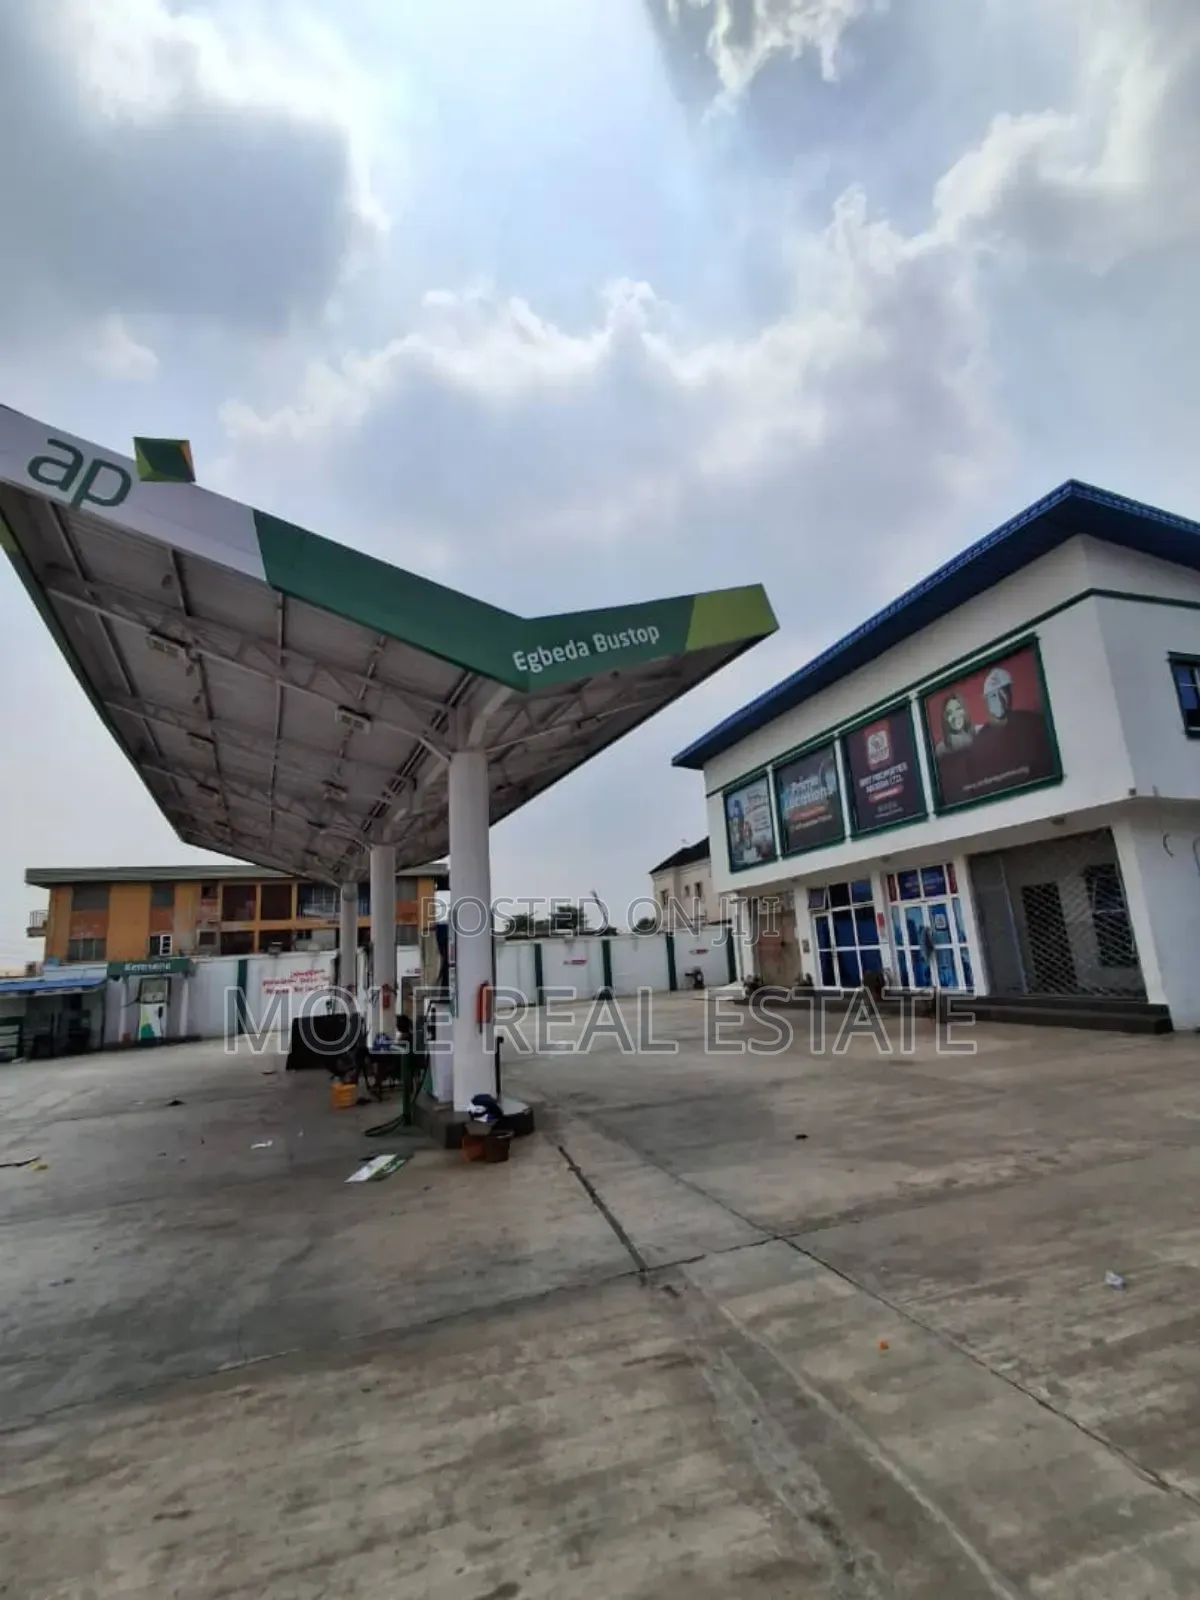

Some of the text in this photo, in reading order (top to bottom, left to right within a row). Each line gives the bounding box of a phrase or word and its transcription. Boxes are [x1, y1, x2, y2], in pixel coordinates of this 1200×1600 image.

[27, 437, 132, 510] ap
[512, 625, 661, 673] Egbeda Bustop
